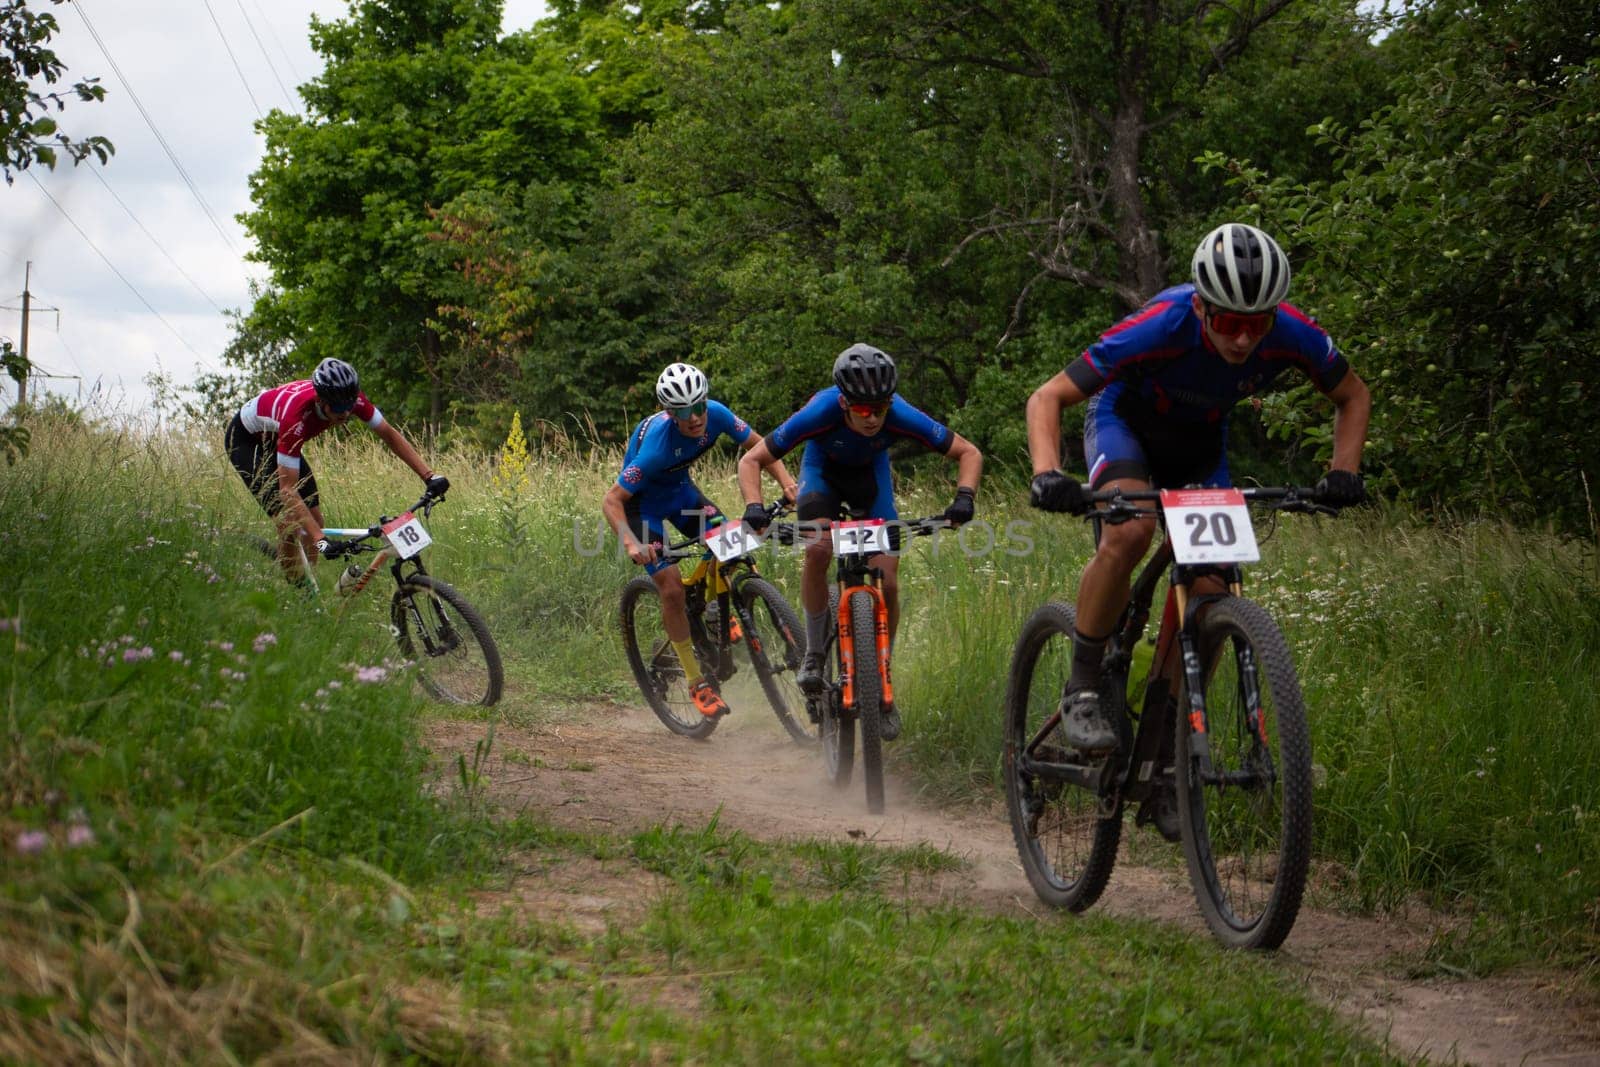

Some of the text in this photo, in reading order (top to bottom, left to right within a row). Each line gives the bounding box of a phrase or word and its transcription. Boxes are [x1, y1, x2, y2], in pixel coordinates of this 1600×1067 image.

[397, 525, 420, 546] 18
[845, 528, 875, 545] 12
[1184, 511, 1237, 547] 20
[718, 530, 744, 550] 14
